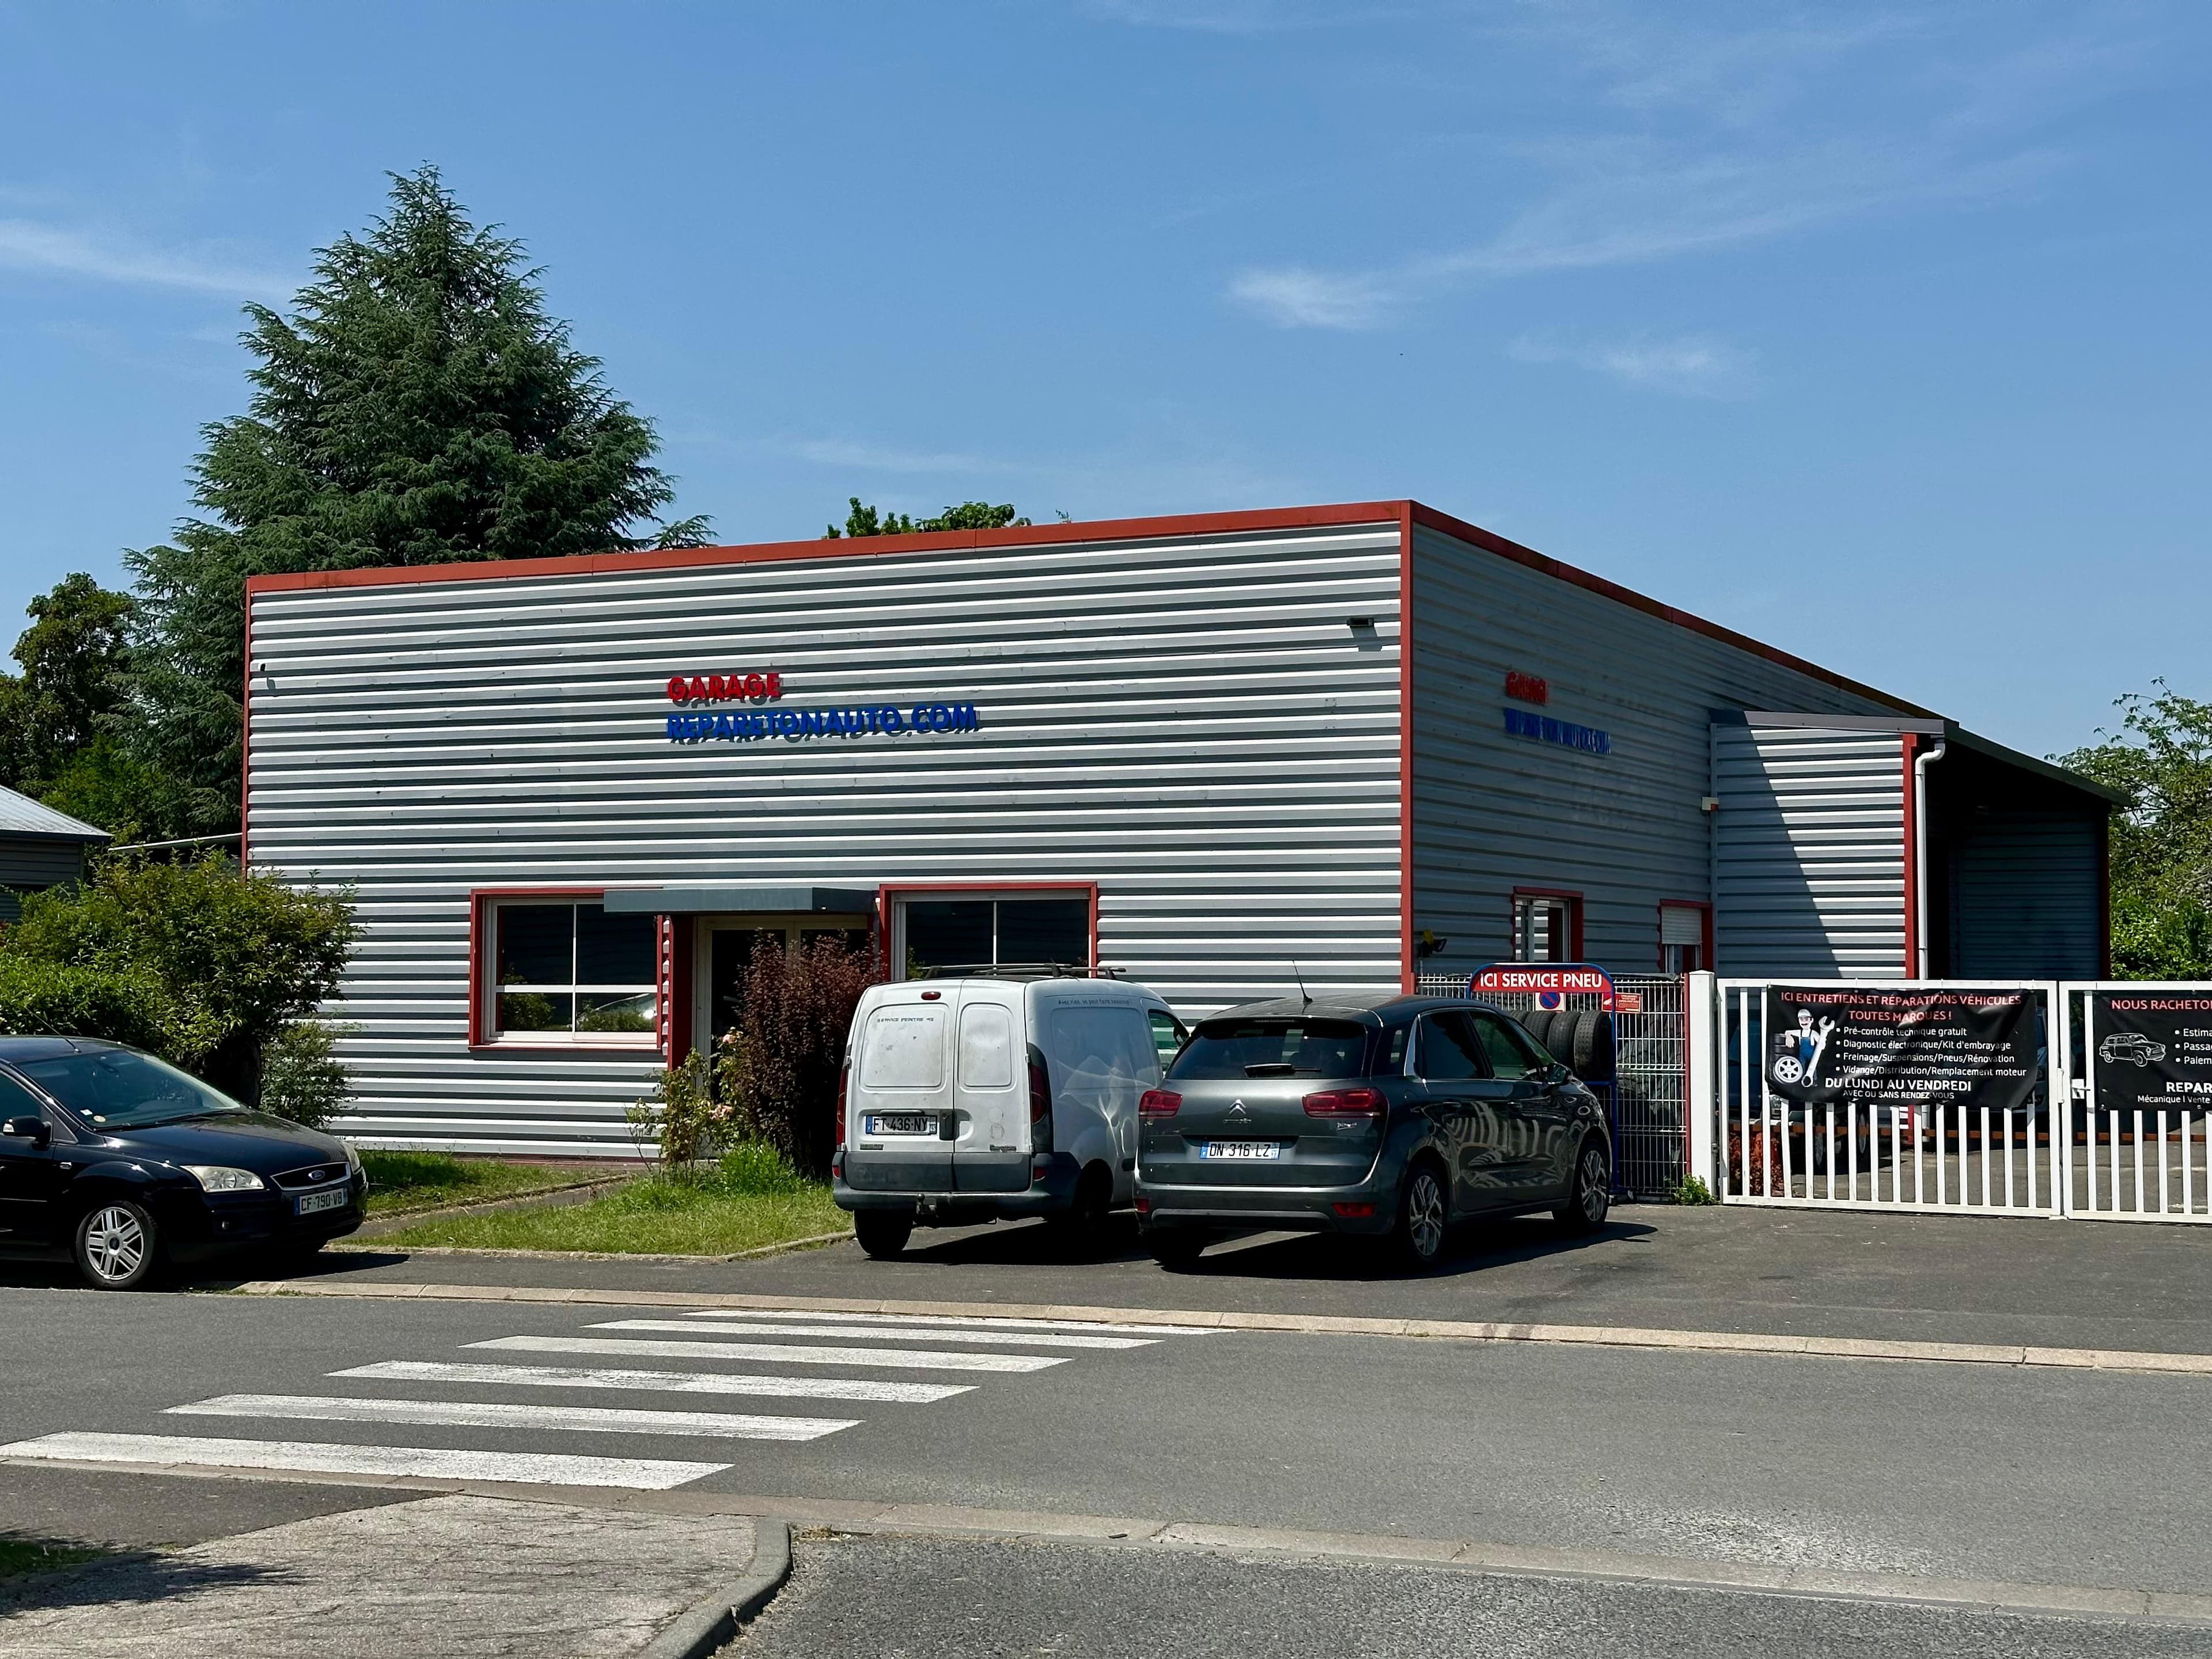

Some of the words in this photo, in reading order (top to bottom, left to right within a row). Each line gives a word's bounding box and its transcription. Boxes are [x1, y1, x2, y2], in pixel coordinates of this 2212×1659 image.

[667, 672, 782, 701] GARAGE
[666, 703, 978, 740] REPARETONAUTO.COM
[1480, 973, 1497, 987] ICI
[1502, 973, 1558, 987] SERVICE
[1563, 974, 1602, 988] PNEU
[1781, 992, 1793, 1001] ICI
[1796, 993, 1864, 1003] ENTRETIENS
[1866, 995, 1879, 1005] ET
[1881, 994, 1957, 1006] RÉPARATIONS
[1960, 994, 2021, 1005] VÉHICULES
[2112, 999, 2147, 1009] NOUS
[2151, 999, 2212, 1009] RACHETO
[1848, 1010, 1890, 1021] TOUTES
[1893, 1011, 1946, 1022] MARQUES
[1843, 1026, 1894, 1036] Pré-contrôle
[1896, 1028, 1936, 1037] technique
[1938, 1027, 1967, 1037] gratuit
[1843, 1039, 1887, 1049] Diagnostic
[1956, 1040, 2011, 1051] d'embrayage
[2184, 1042, 2212, 1052] Passa
[1995, 1067, 2027, 1076] moteur
[1825, 1077, 1842, 1088] DU
[1844, 1078, 1883, 1089] LUNDI
[1887, 1080, 1904, 1090] AU
[1907, 1080, 1971, 1092] VENDREDI
[2138, 1094, 2181, 1103] Mécanique
